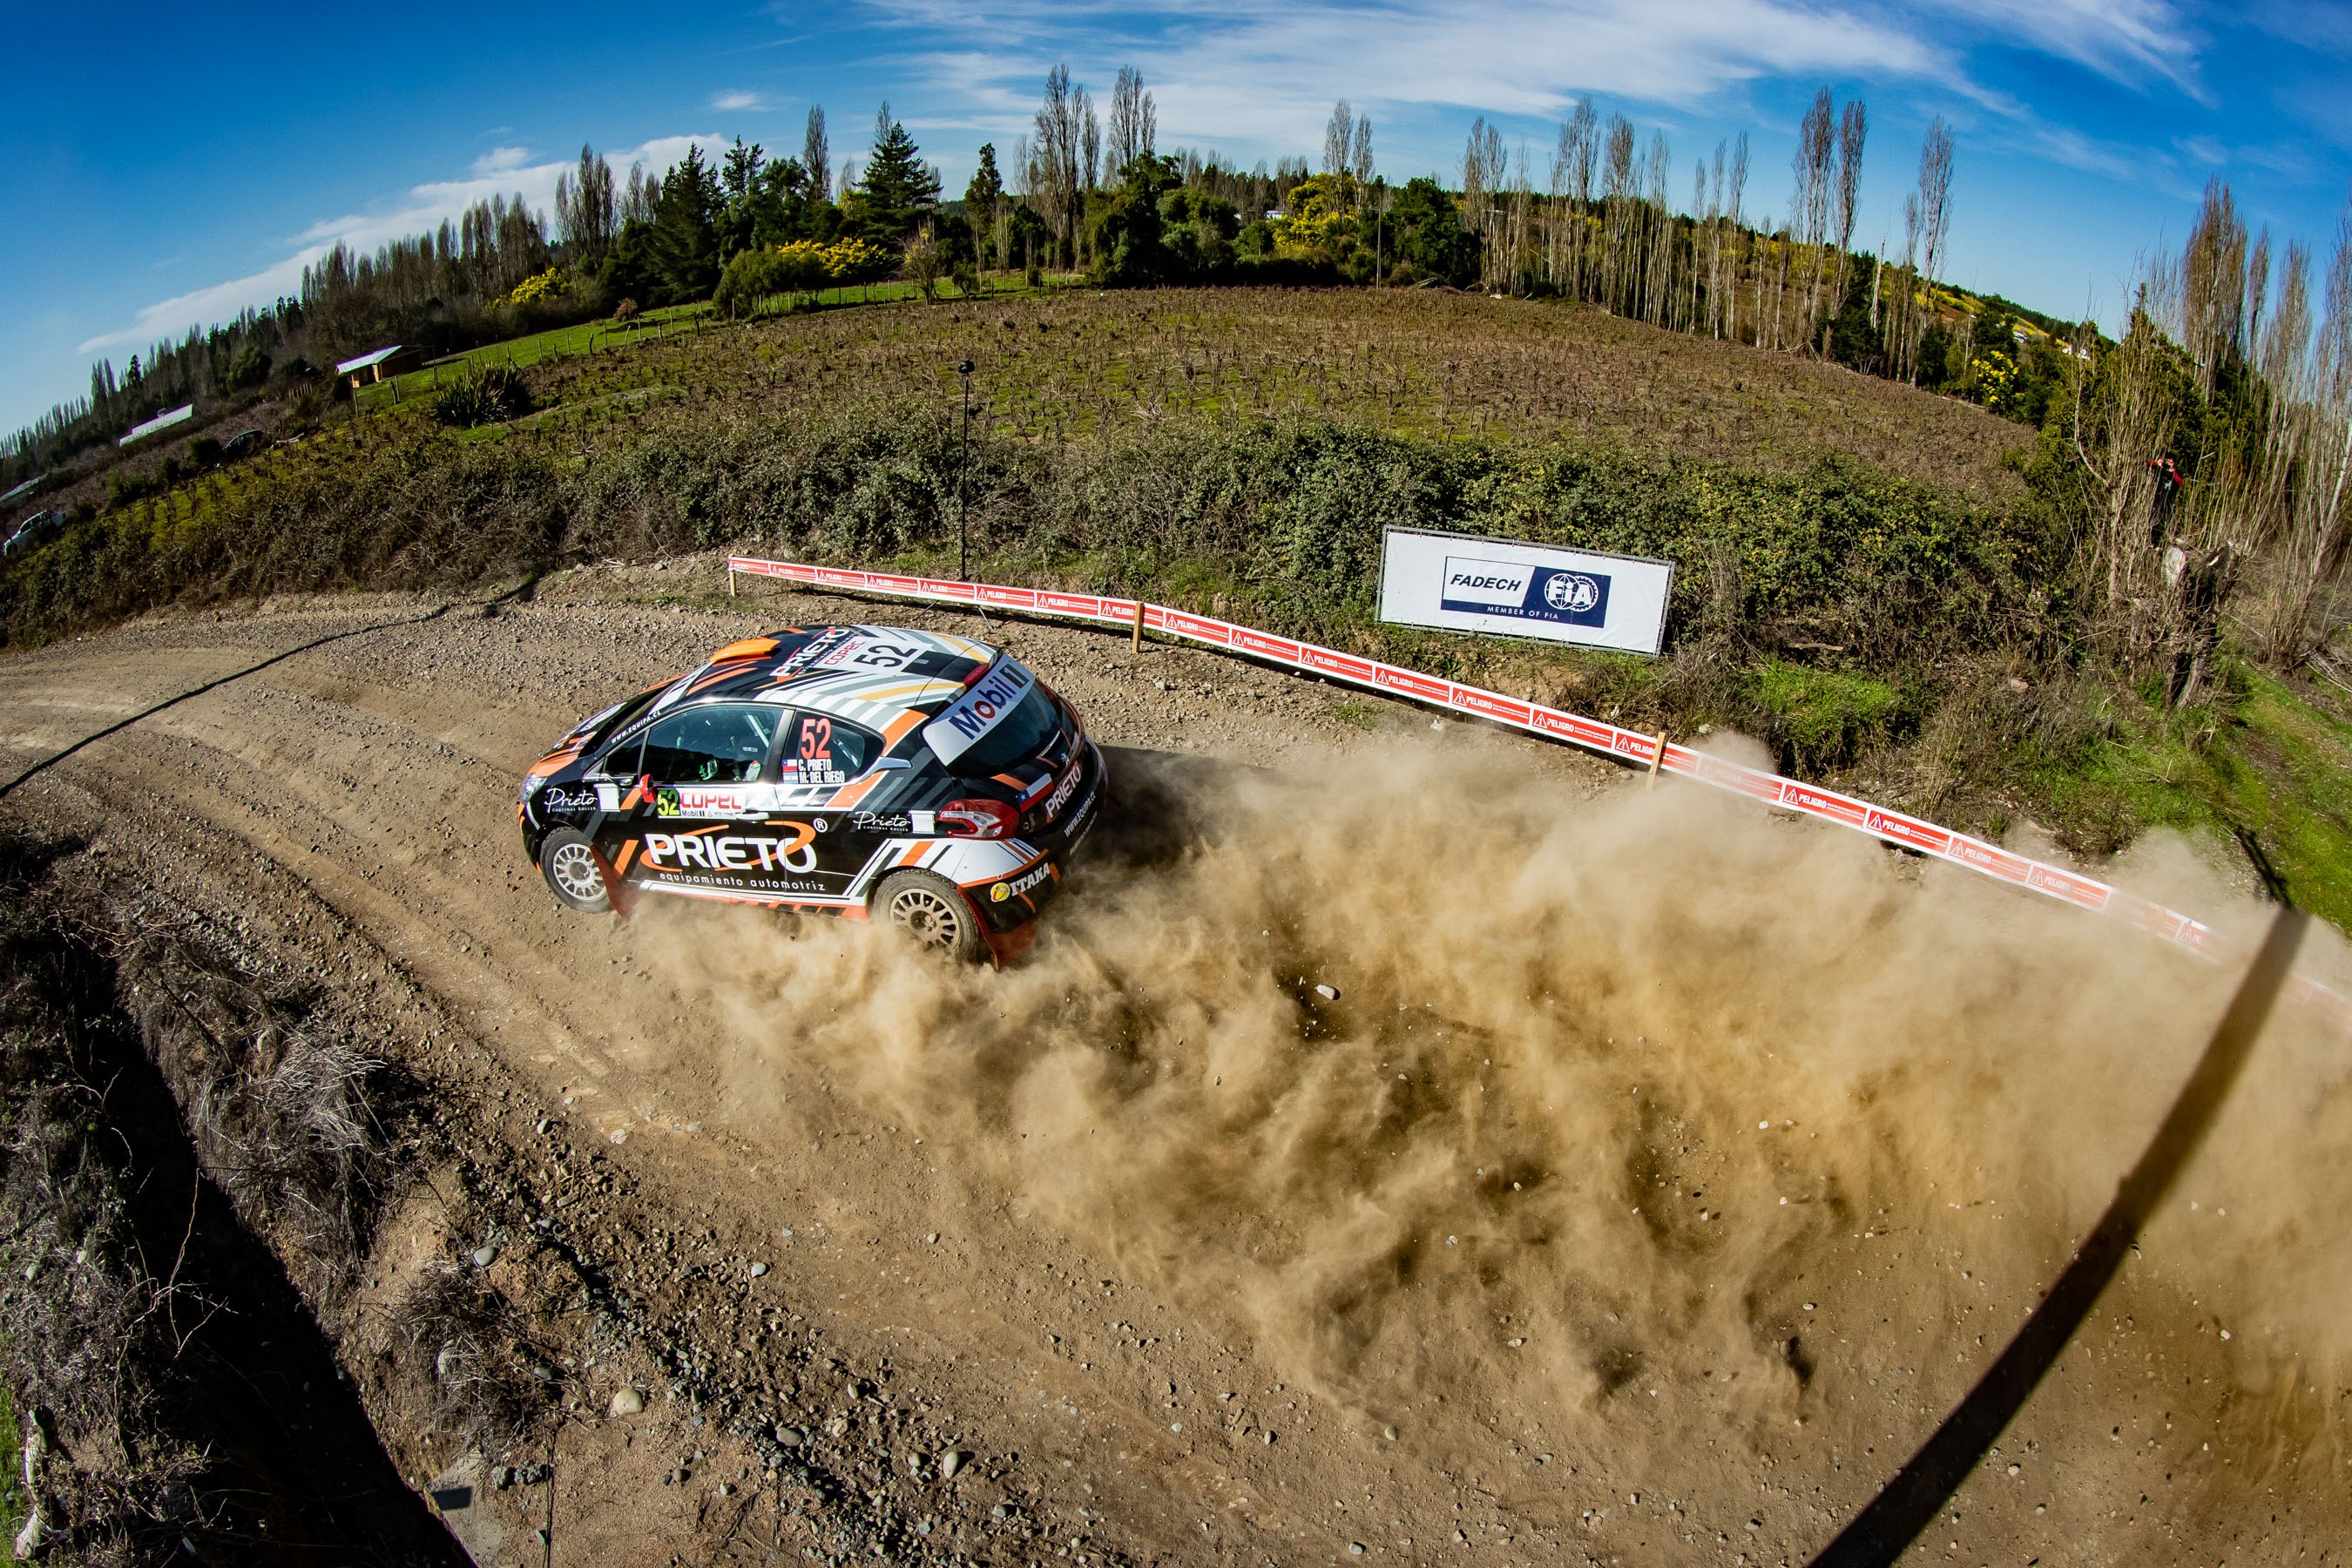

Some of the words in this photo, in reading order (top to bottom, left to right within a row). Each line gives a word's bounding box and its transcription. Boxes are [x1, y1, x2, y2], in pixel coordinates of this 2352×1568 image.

[929, 584, 949, 594] PELIGRO
[1450, 574, 1522, 591] FADECH
[986, 590, 1006, 600] PELIGRO
[1047, 598, 1069, 608] PELIGRO
[1112, 605, 1134, 617] PELIGRO
[1487, 605, 1524, 616] MEMBER
[1544, 612, 1559, 620] FIA
[1177, 618, 1200, 632] PELIGRO
[1243, 636, 1267, 650] PELIGRO
[769, 629, 850, 677] PRIETO
[853, 645, 919, 668] 52
[1314, 654, 1339, 669] PELIGRO
[1388, 674, 1415, 690] PELIGRO
[948, 675, 1017, 740] Mobil
[1466, 695, 1493, 711] PELIGRO
[611, 710, 662, 745] WWW.EQUIPA.CL
[1547, 718, 1575, 733] PELIGRO
[801, 718, 832, 760] 52
[1630, 741, 1655, 756] PELIGR
[798, 760, 806, 772] C.
[807, 759, 832, 771] PRIETO
[799, 771, 809, 784] M.
[810, 771, 823, 783] DEL
[824, 771, 845, 783] RIEGO
[544, 787, 598, 813] Prieto
[1045, 766, 1082, 818] PRIETO
[657, 789, 680, 816] 52
[1798, 794, 1828, 809] PELIGRO
[853, 810, 911, 830] Prieto
[1882, 820, 1910, 836] PELIGRO
[644, 834, 817, 874] PRIETO
[1964, 848, 1992, 865] PELIGRO
[659, 871, 743, 887] equipamiento
[750, 878, 827, 892] automotriz
[1010, 862, 1051, 897] ITAKA
